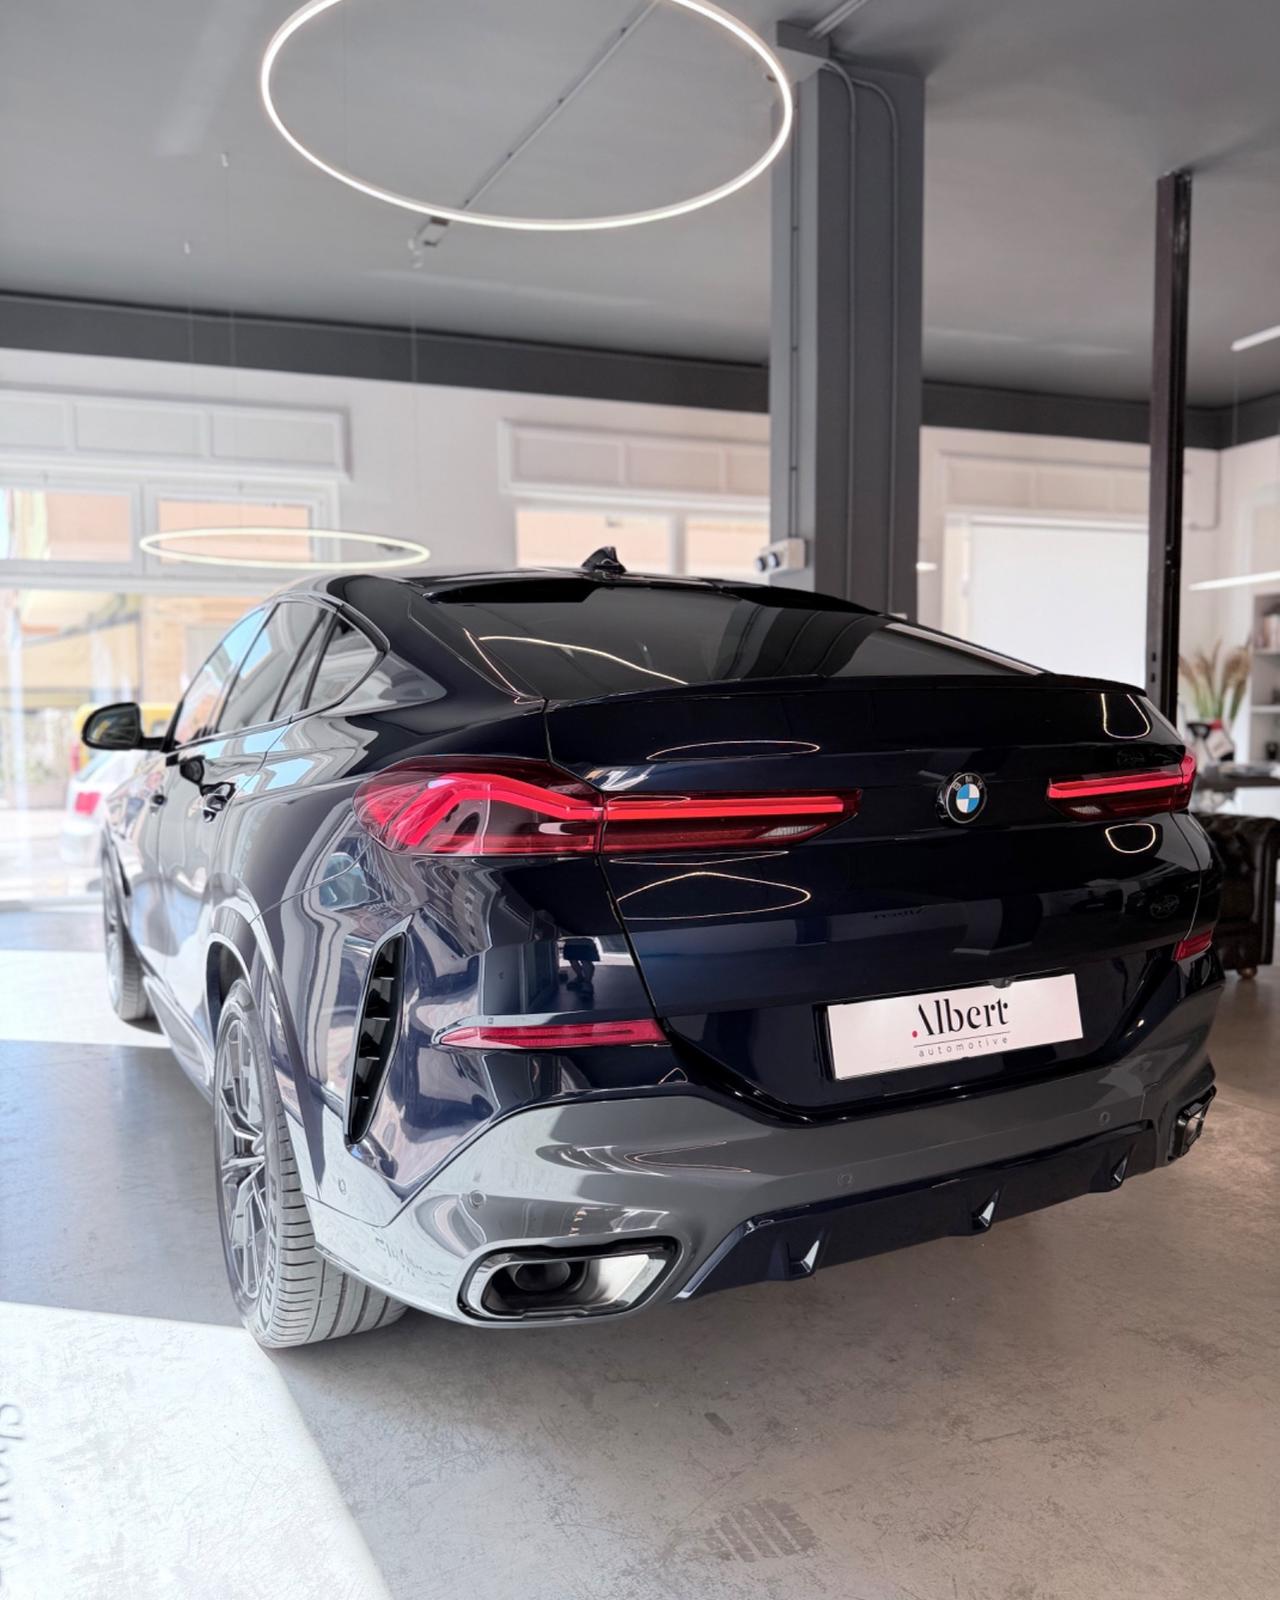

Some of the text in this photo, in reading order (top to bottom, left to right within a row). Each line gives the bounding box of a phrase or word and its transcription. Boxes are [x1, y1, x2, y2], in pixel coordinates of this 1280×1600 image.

[952, 775, 985, 791] BMW
[912, 997, 1009, 1036] Albert
[918, 1037, 1008, 1057] automotive
[264, 1207, 277, 1306] ZERO
